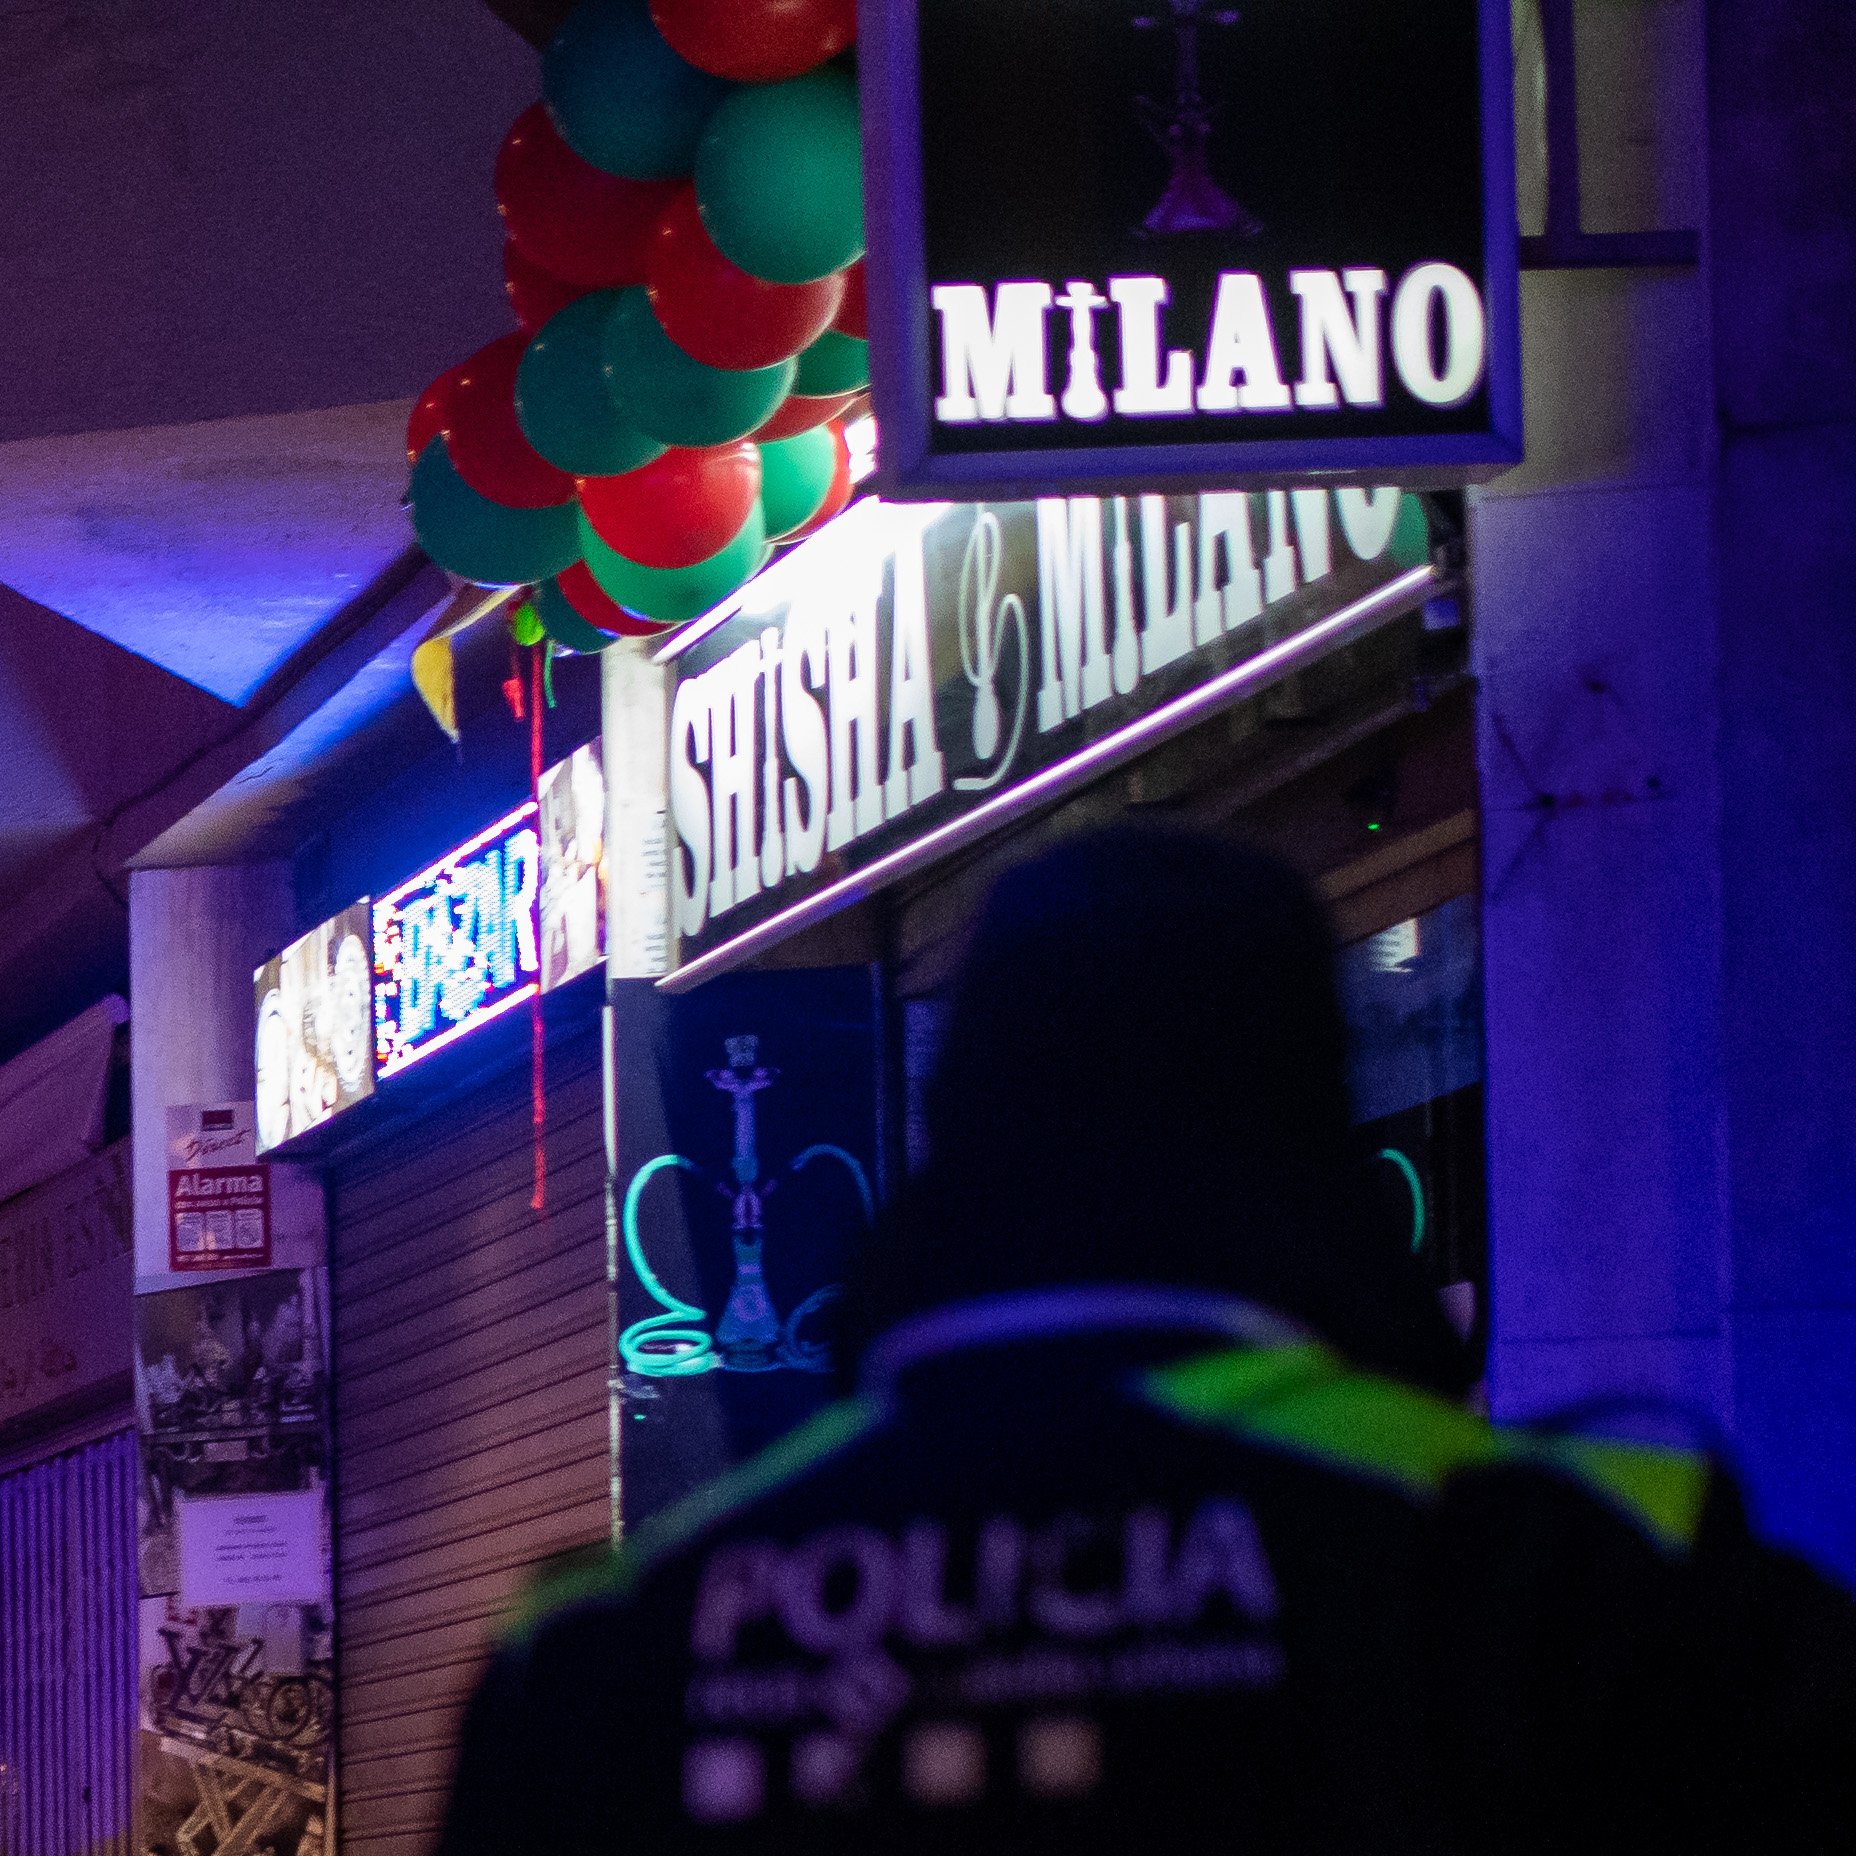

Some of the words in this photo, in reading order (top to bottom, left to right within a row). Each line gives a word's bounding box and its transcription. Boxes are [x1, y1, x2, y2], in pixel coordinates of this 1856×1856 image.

[931, 260, 1485, 424] MILANO
[670, 525, 944, 937] SHISHA
[1035, 486, 1401, 734] MIL
[174, 1173, 264, 1197] Alarma
